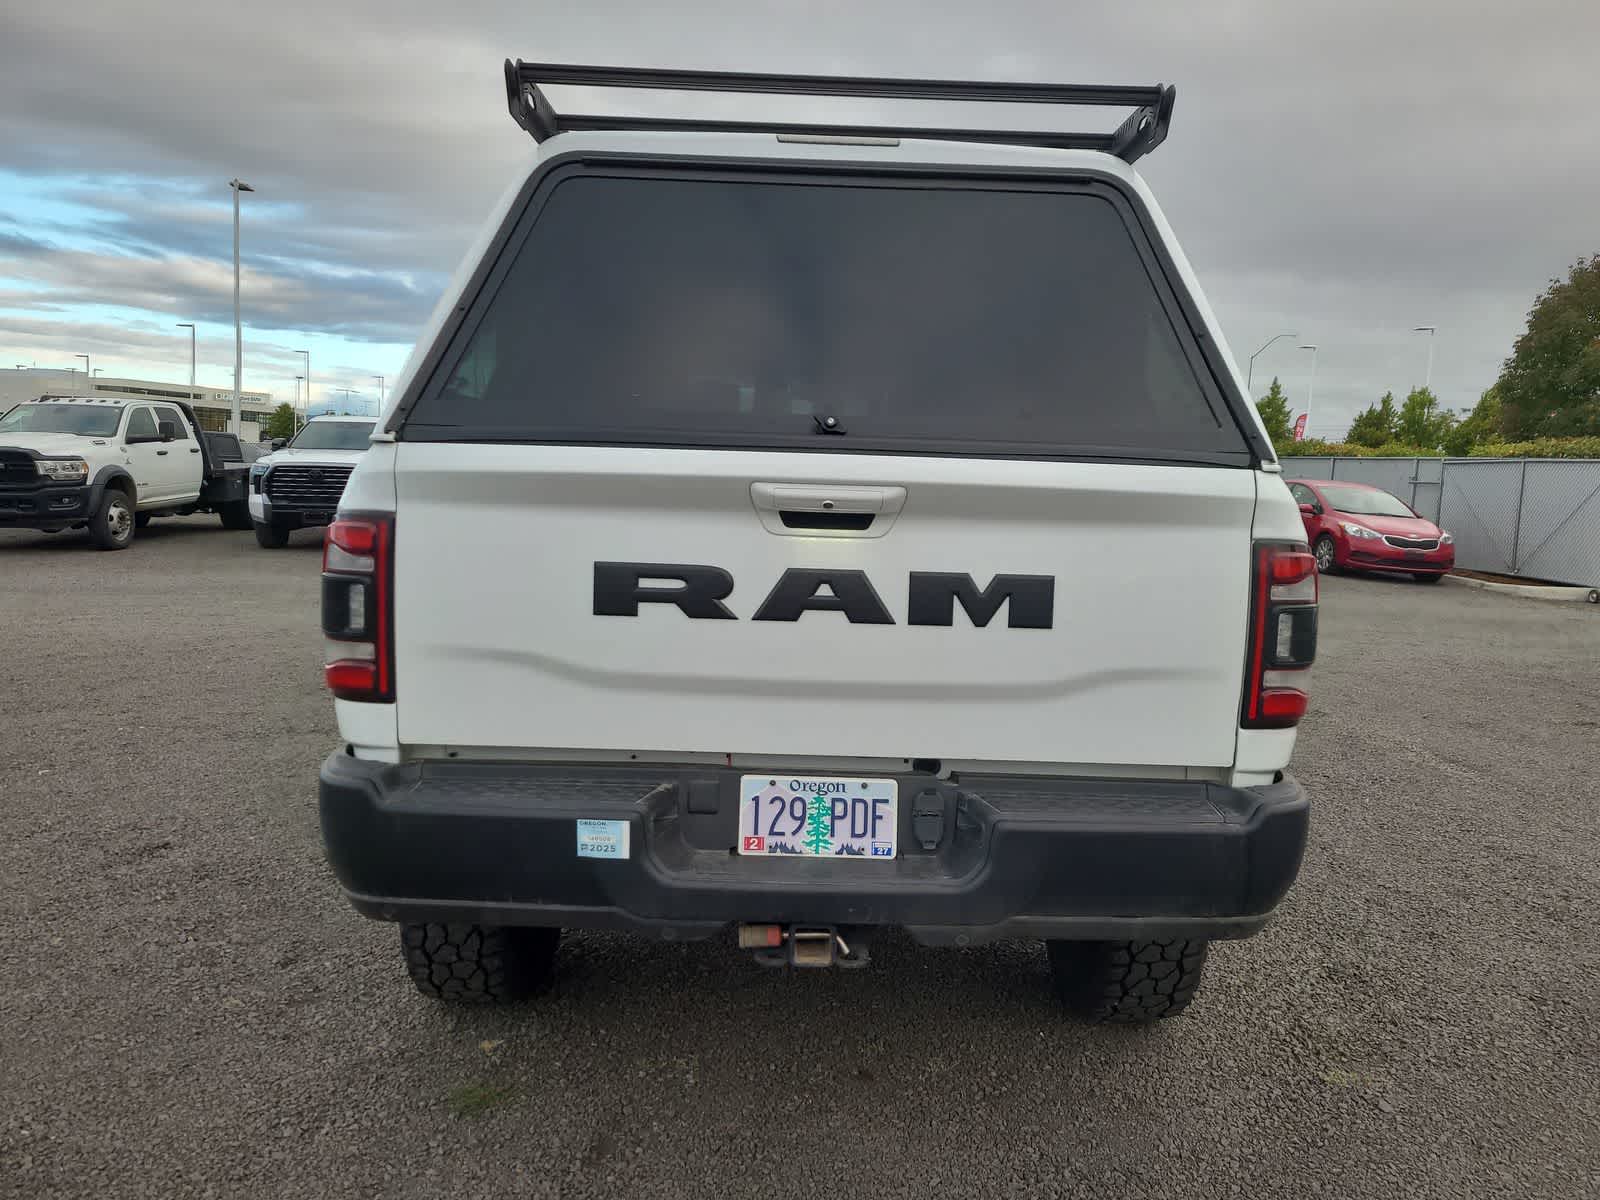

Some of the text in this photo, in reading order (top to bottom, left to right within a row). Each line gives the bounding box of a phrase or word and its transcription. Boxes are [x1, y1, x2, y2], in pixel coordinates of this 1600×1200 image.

[593, 560, 1056, 630] RAM
[789, 779, 847, 796] Oregon
[751, 795, 890, 839] 129 PDF
[590, 844, 616, 853] 2025
